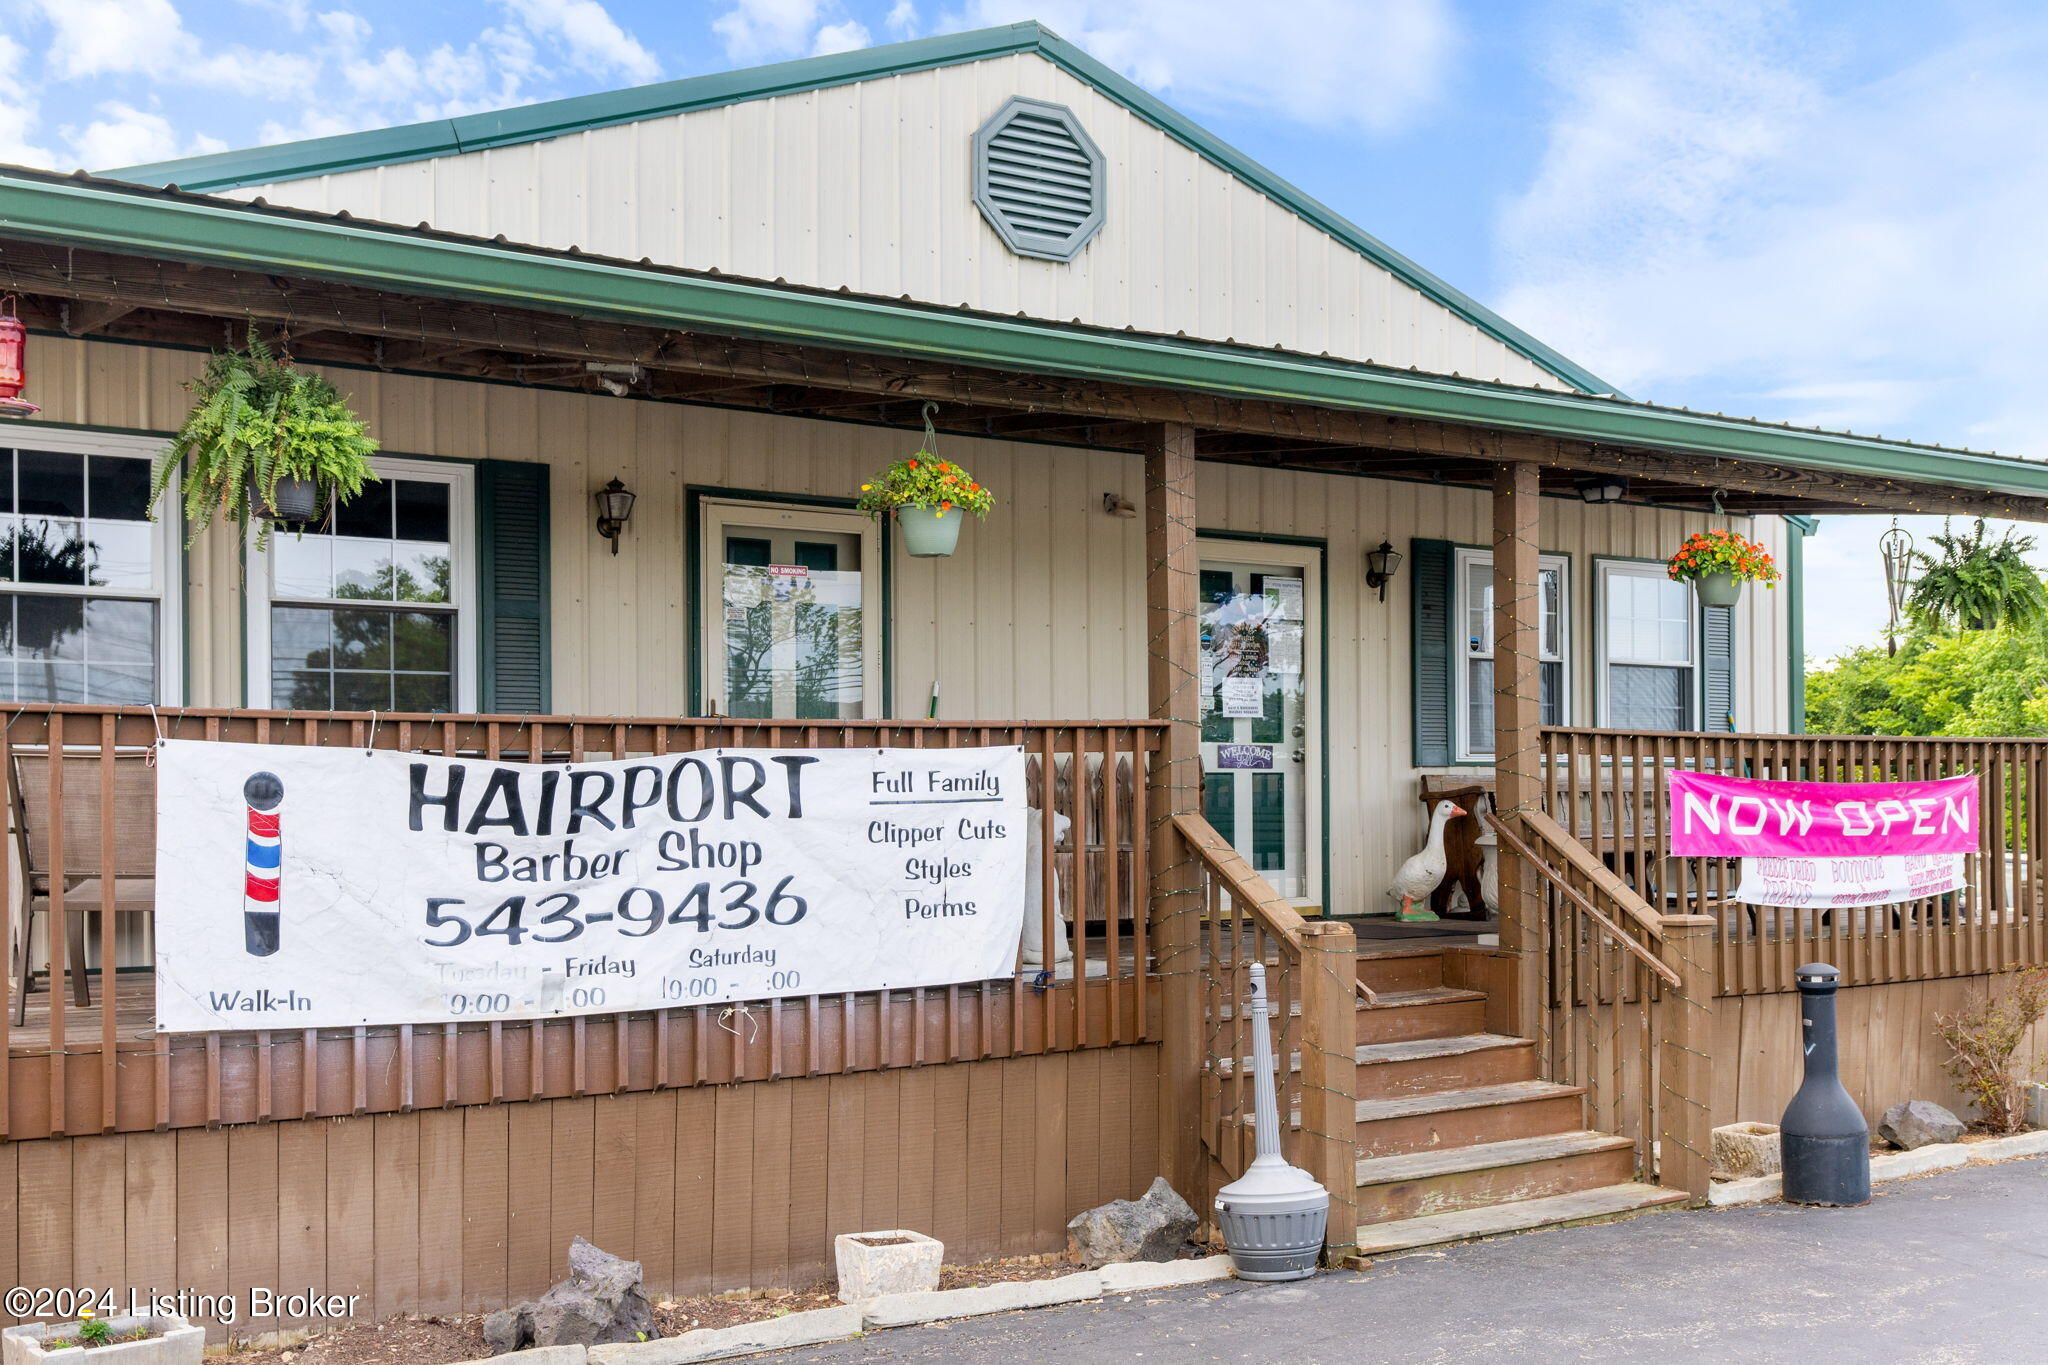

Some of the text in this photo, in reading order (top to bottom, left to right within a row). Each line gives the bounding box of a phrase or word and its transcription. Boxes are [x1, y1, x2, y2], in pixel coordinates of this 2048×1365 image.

[770, 566, 806, 576] NO SMOKING
[1220, 745, 1272, 761] WELCOME
[409, 755, 820, 837] HAIRPORT
[872, 769, 1001, 797] Full Family
[1684, 791, 1971, 836] NOW OPEN
[867, 818, 1007, 849] Clipper Cuts
[473, 827, 762, 882] Barber Shop
[905, 857, 972, 885] Styles
[1831, 856, 1885, 883] BOUTIQUE
[424, 875, 808, 947] 543-9436
[905, 898, 977, 919] Perms
[565, 955, 636, 978] Friday
[688, 944, 777, 969] Saturday
[209, 989, 312, 1012] Walk-In
[662, 975, 717, 1000] 10:00
[450, 993, 510, 1015] 9:00
